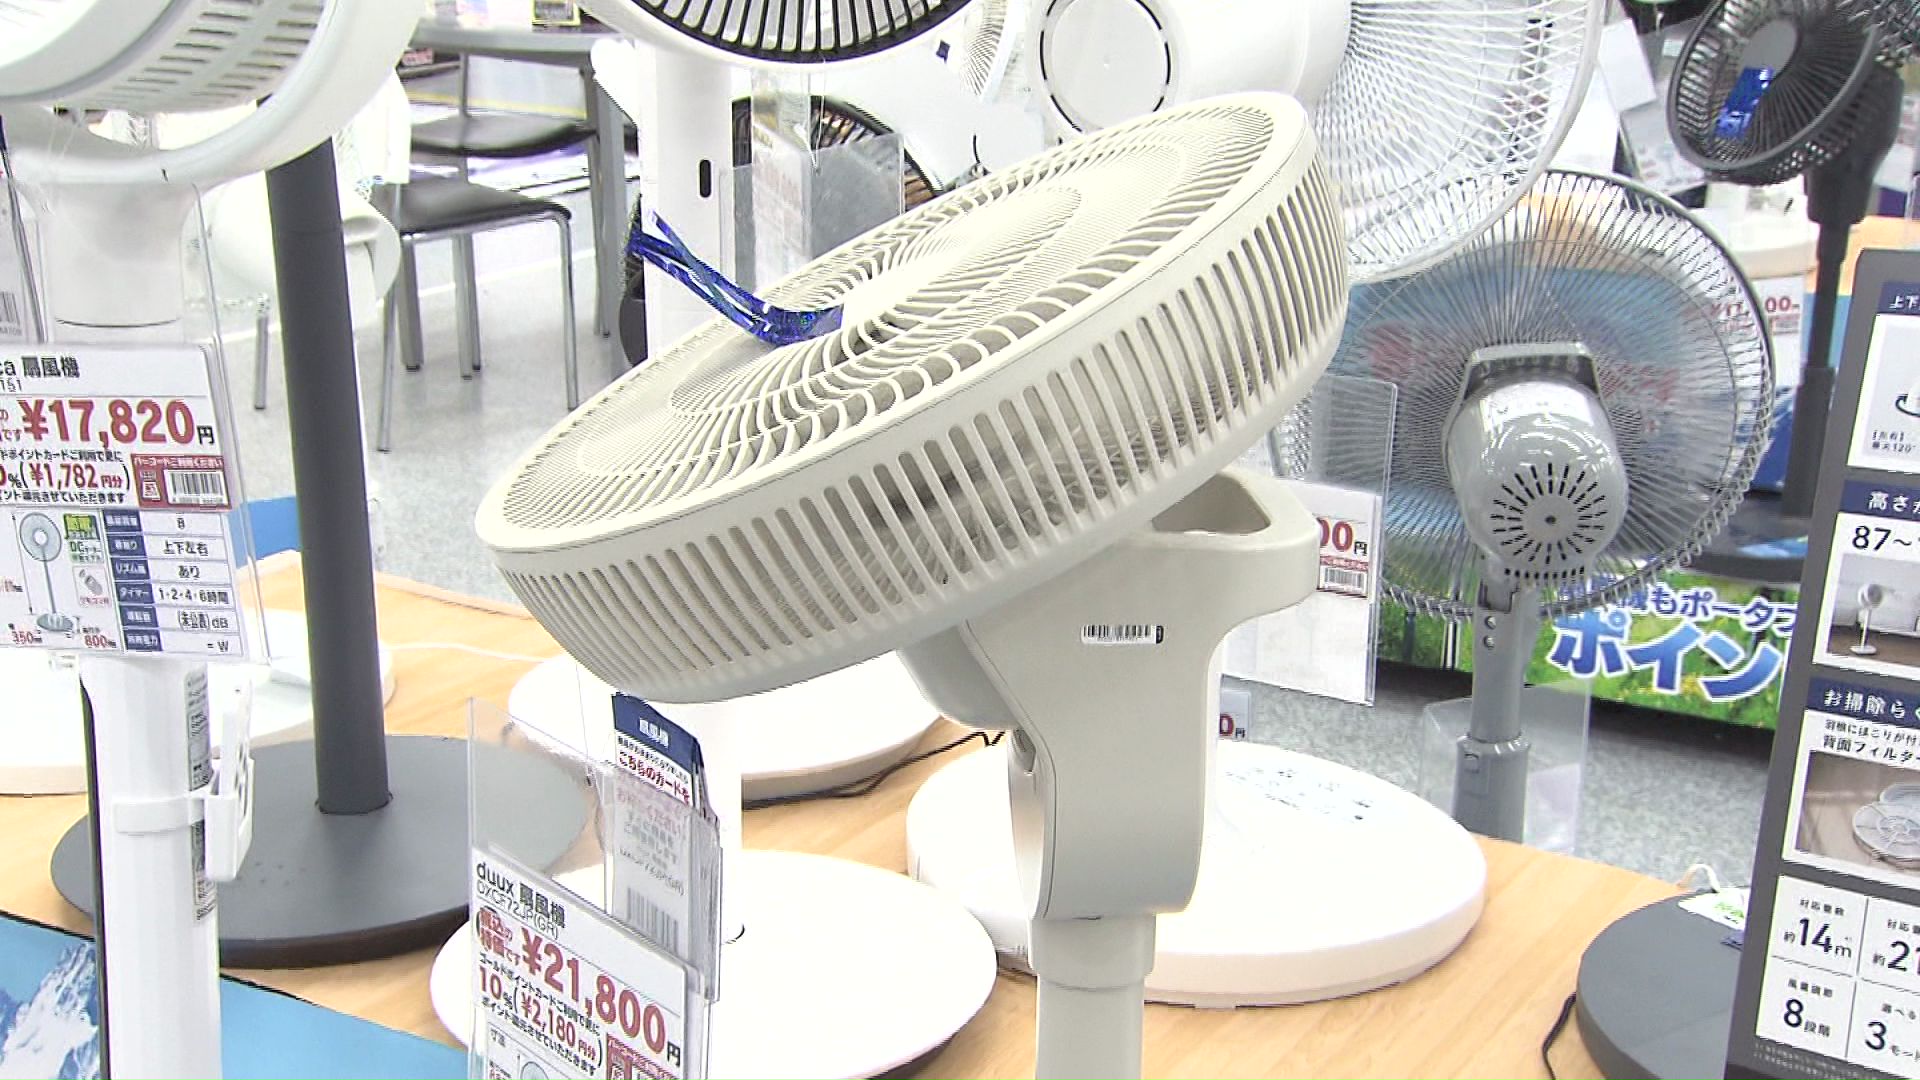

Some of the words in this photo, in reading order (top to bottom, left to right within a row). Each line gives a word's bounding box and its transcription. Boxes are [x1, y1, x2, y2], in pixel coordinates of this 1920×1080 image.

[163, 540, 209, 556] 上下左右
[178, 565, 200, 579] あり
[1549, 608, 1783, 701] ポイン
[477, 862, 514, 898] duux
